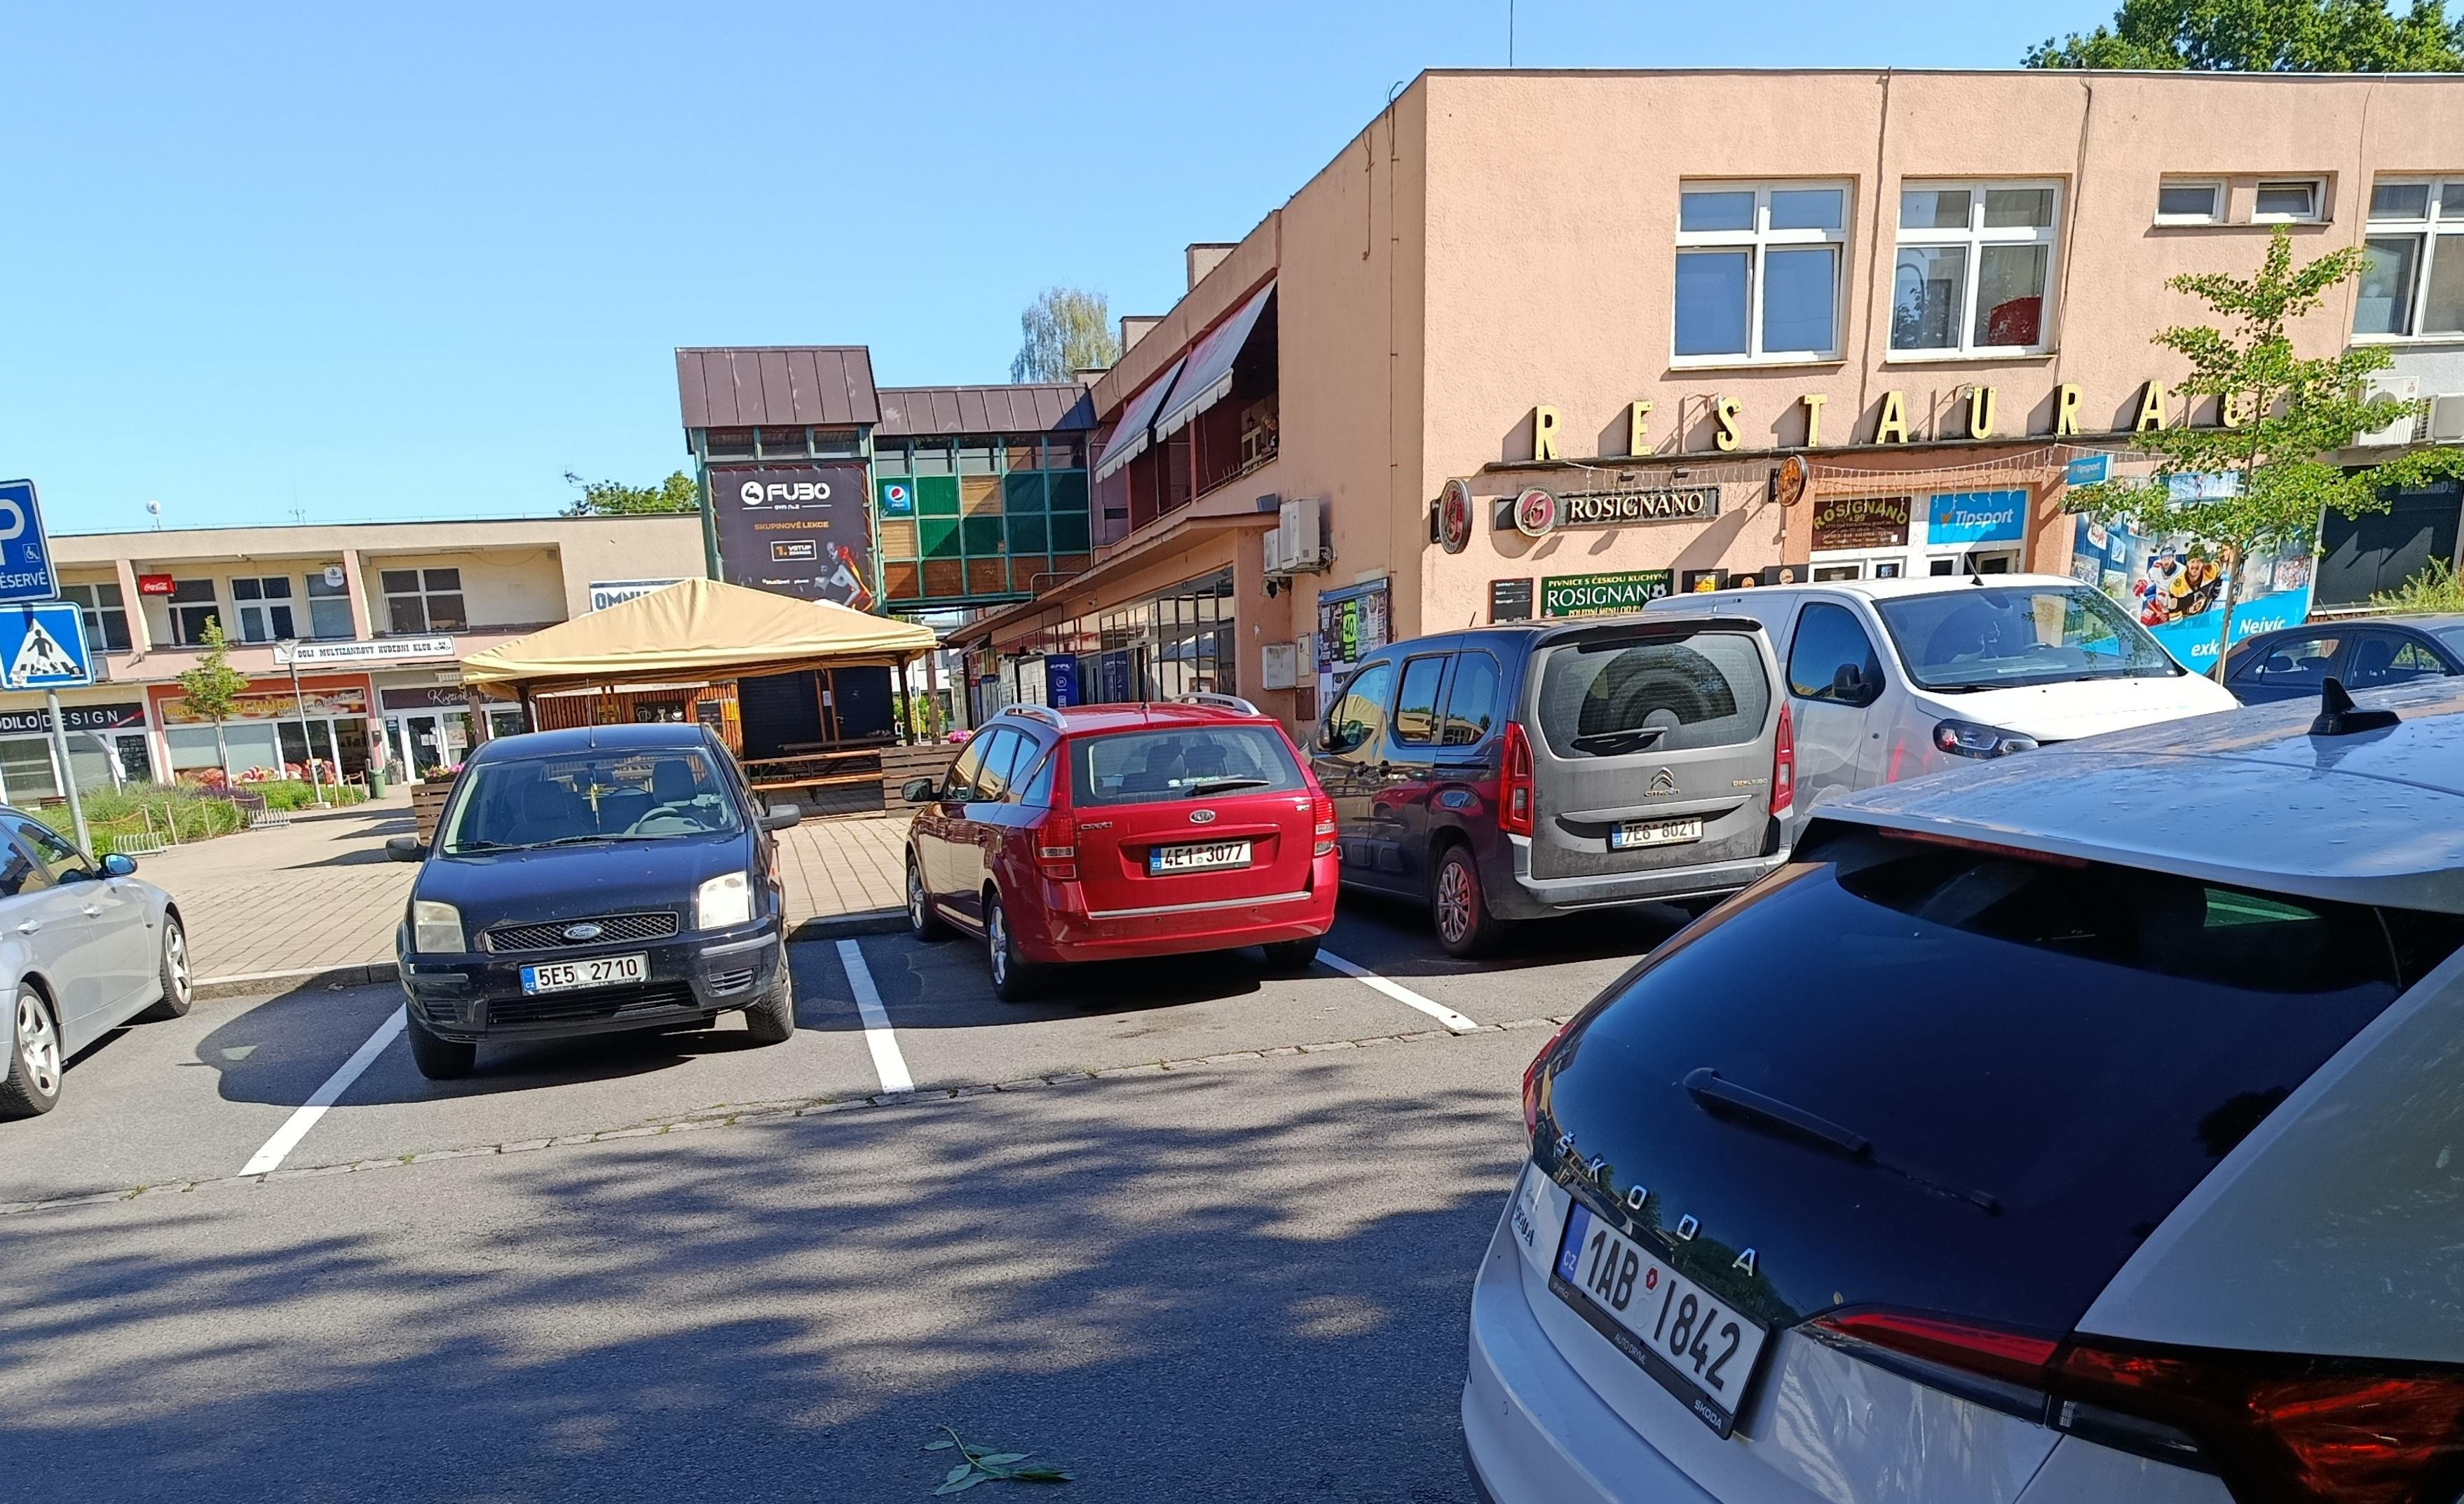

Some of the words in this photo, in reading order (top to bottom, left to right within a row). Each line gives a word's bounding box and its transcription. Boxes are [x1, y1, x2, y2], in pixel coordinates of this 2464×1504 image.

[1535, 380, 2317, 460] RESTAURAC
[1570, 492, 1704, 518] ROSIGNANO
[1813, 501, 1907, 530] ROSGNANO
[754, 522, 801, 530] SKUPINOVÉ
[1956, 508, 2014, 529] Tipsport
[1548, 578, 1583, 588] PIVNICE
[1591, 575, 1626, 584] ČESKOU
[1628, 571, 1668, 582] KUCHYNÍ
[0, 715, 38, 730] DILO
[1194, 811, 1214, 820] KIA
[1164, 847, 1192, 866] 4E1
[1206, 843, 1244, 862] 3077
[571, 927, 597, 937] Ford
[538, 965, 576, 987] 5E5
[590, 958, 639, 981] 2710
[1553, 1131, 1757, 1276] ŠKODA
[1563, 1249, 1577, 1271] CZ
[1587, 1230, 1639, 1311] 1AB
